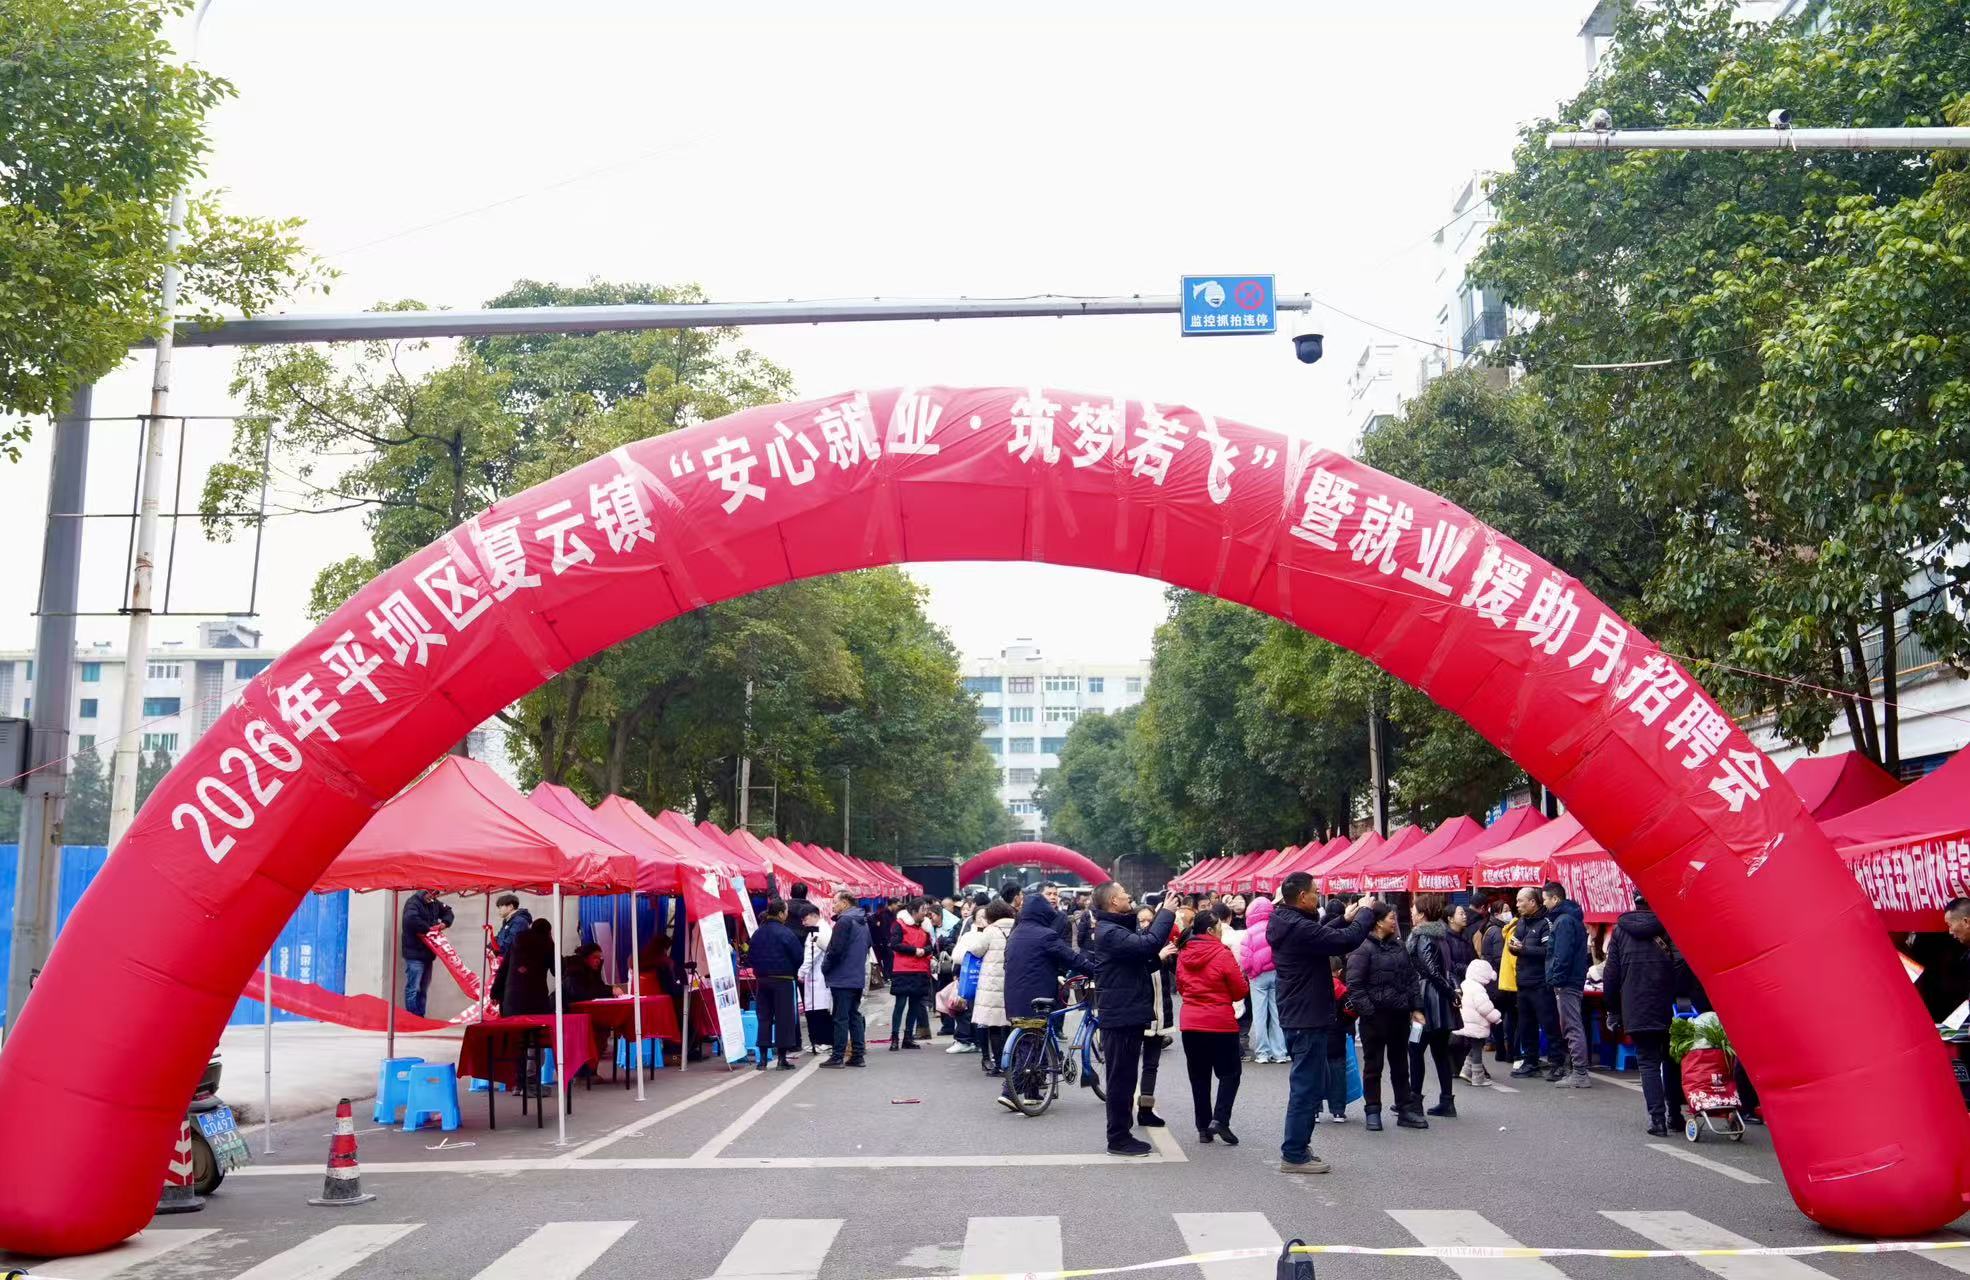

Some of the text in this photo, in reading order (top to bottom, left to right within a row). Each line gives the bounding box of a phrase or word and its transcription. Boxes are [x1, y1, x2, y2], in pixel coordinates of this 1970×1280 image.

[1190, 314, 1269, 328] 监控抓拍违停
